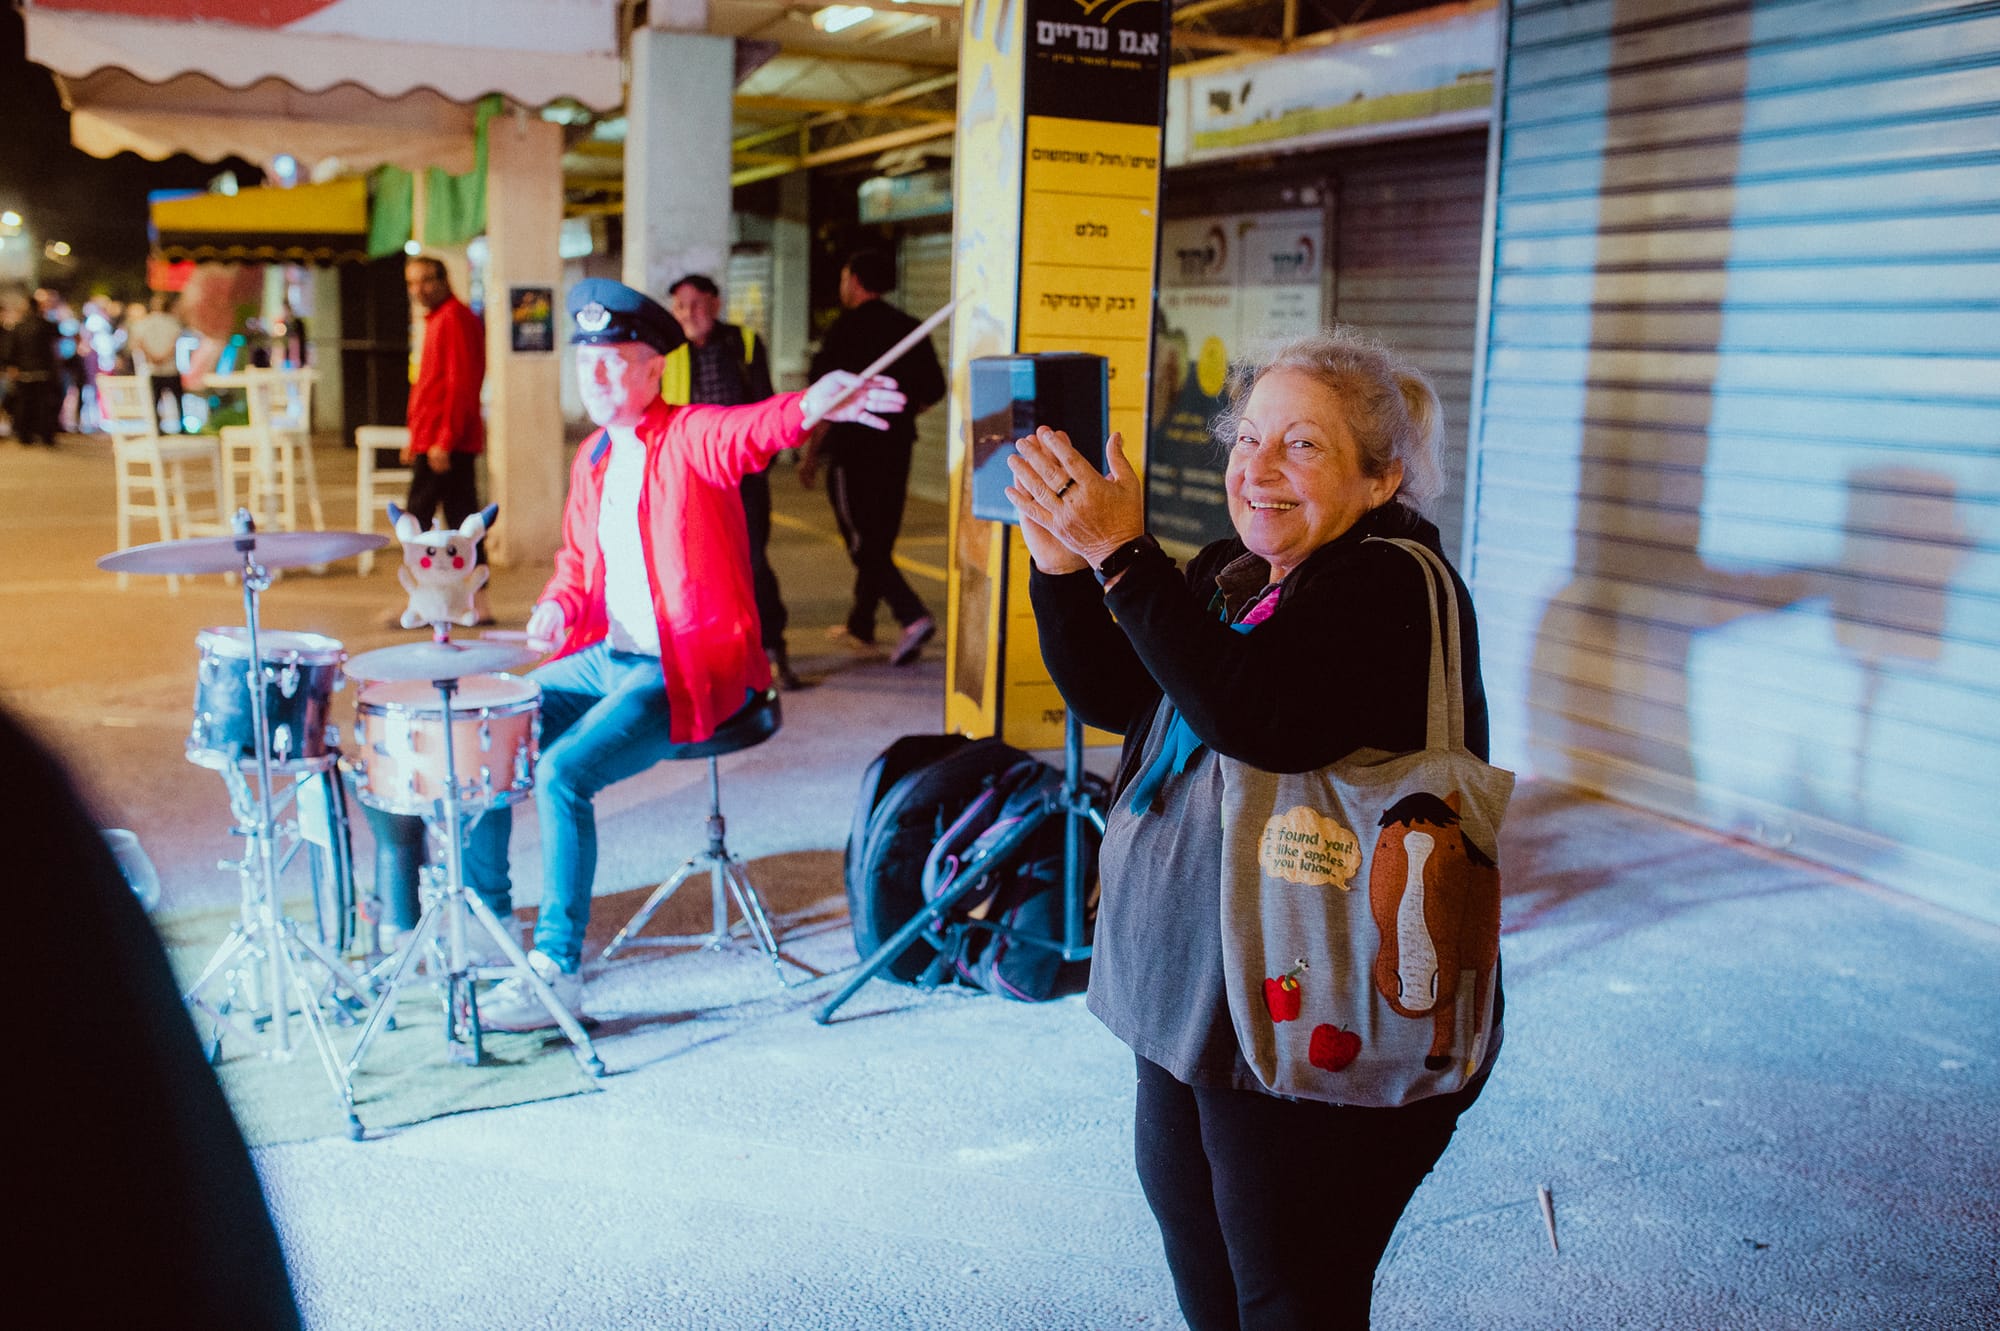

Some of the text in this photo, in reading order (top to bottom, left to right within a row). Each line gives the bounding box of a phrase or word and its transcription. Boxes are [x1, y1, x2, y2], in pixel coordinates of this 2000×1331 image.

[1037, 21, 1109, 51] נהריים
[1075, 222, 1108, 237] מלט
[1041, 294, 1135, 313] דבק קרמיקה
[1265, 827, 1354, 855] I found you!
[1265, 845, 1273, 855] I
[1278, 844, 1300, 857] like
[1274, 858, 1295, 869] you
